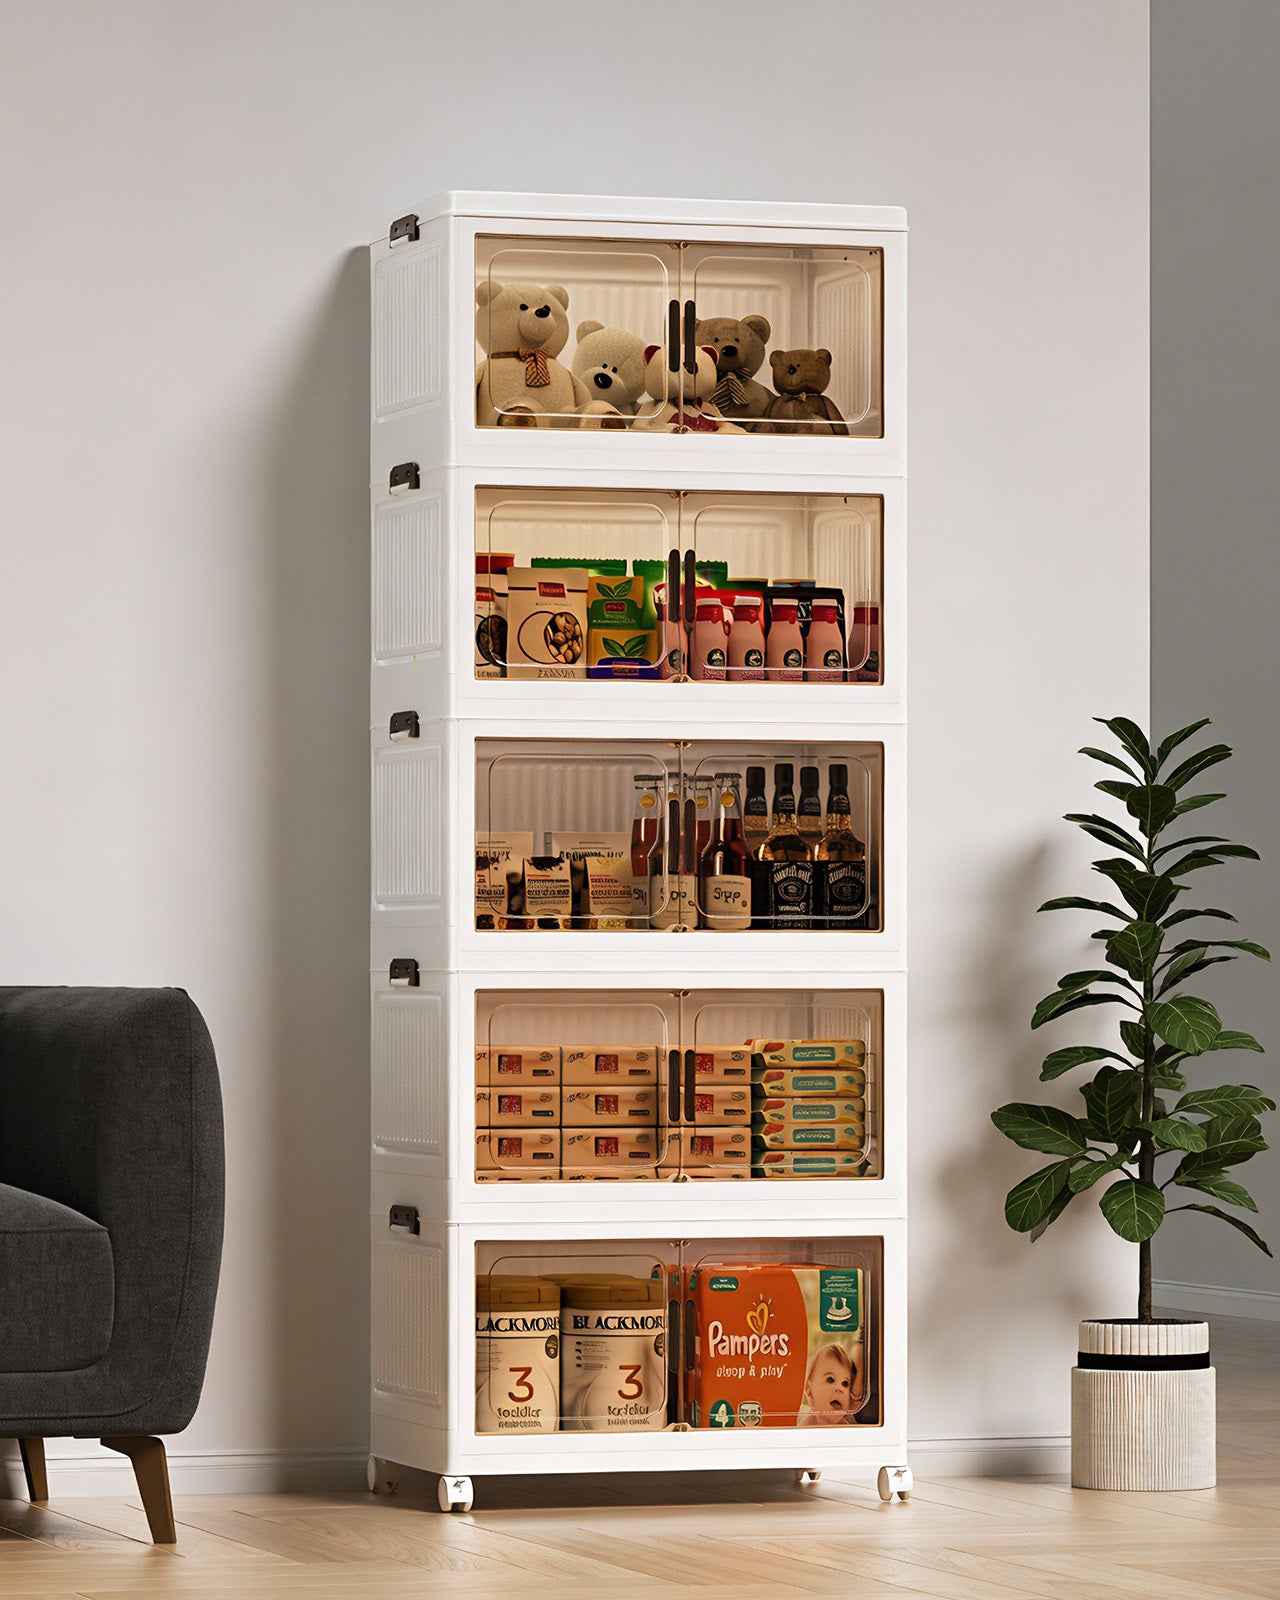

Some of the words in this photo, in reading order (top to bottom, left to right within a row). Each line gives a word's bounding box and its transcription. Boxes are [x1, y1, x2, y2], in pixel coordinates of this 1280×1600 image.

[708, 1320, 789, 1362] Pampers
[507, 1366, 534, 1403] 3
[617, 1364, 643, 1400] 3
